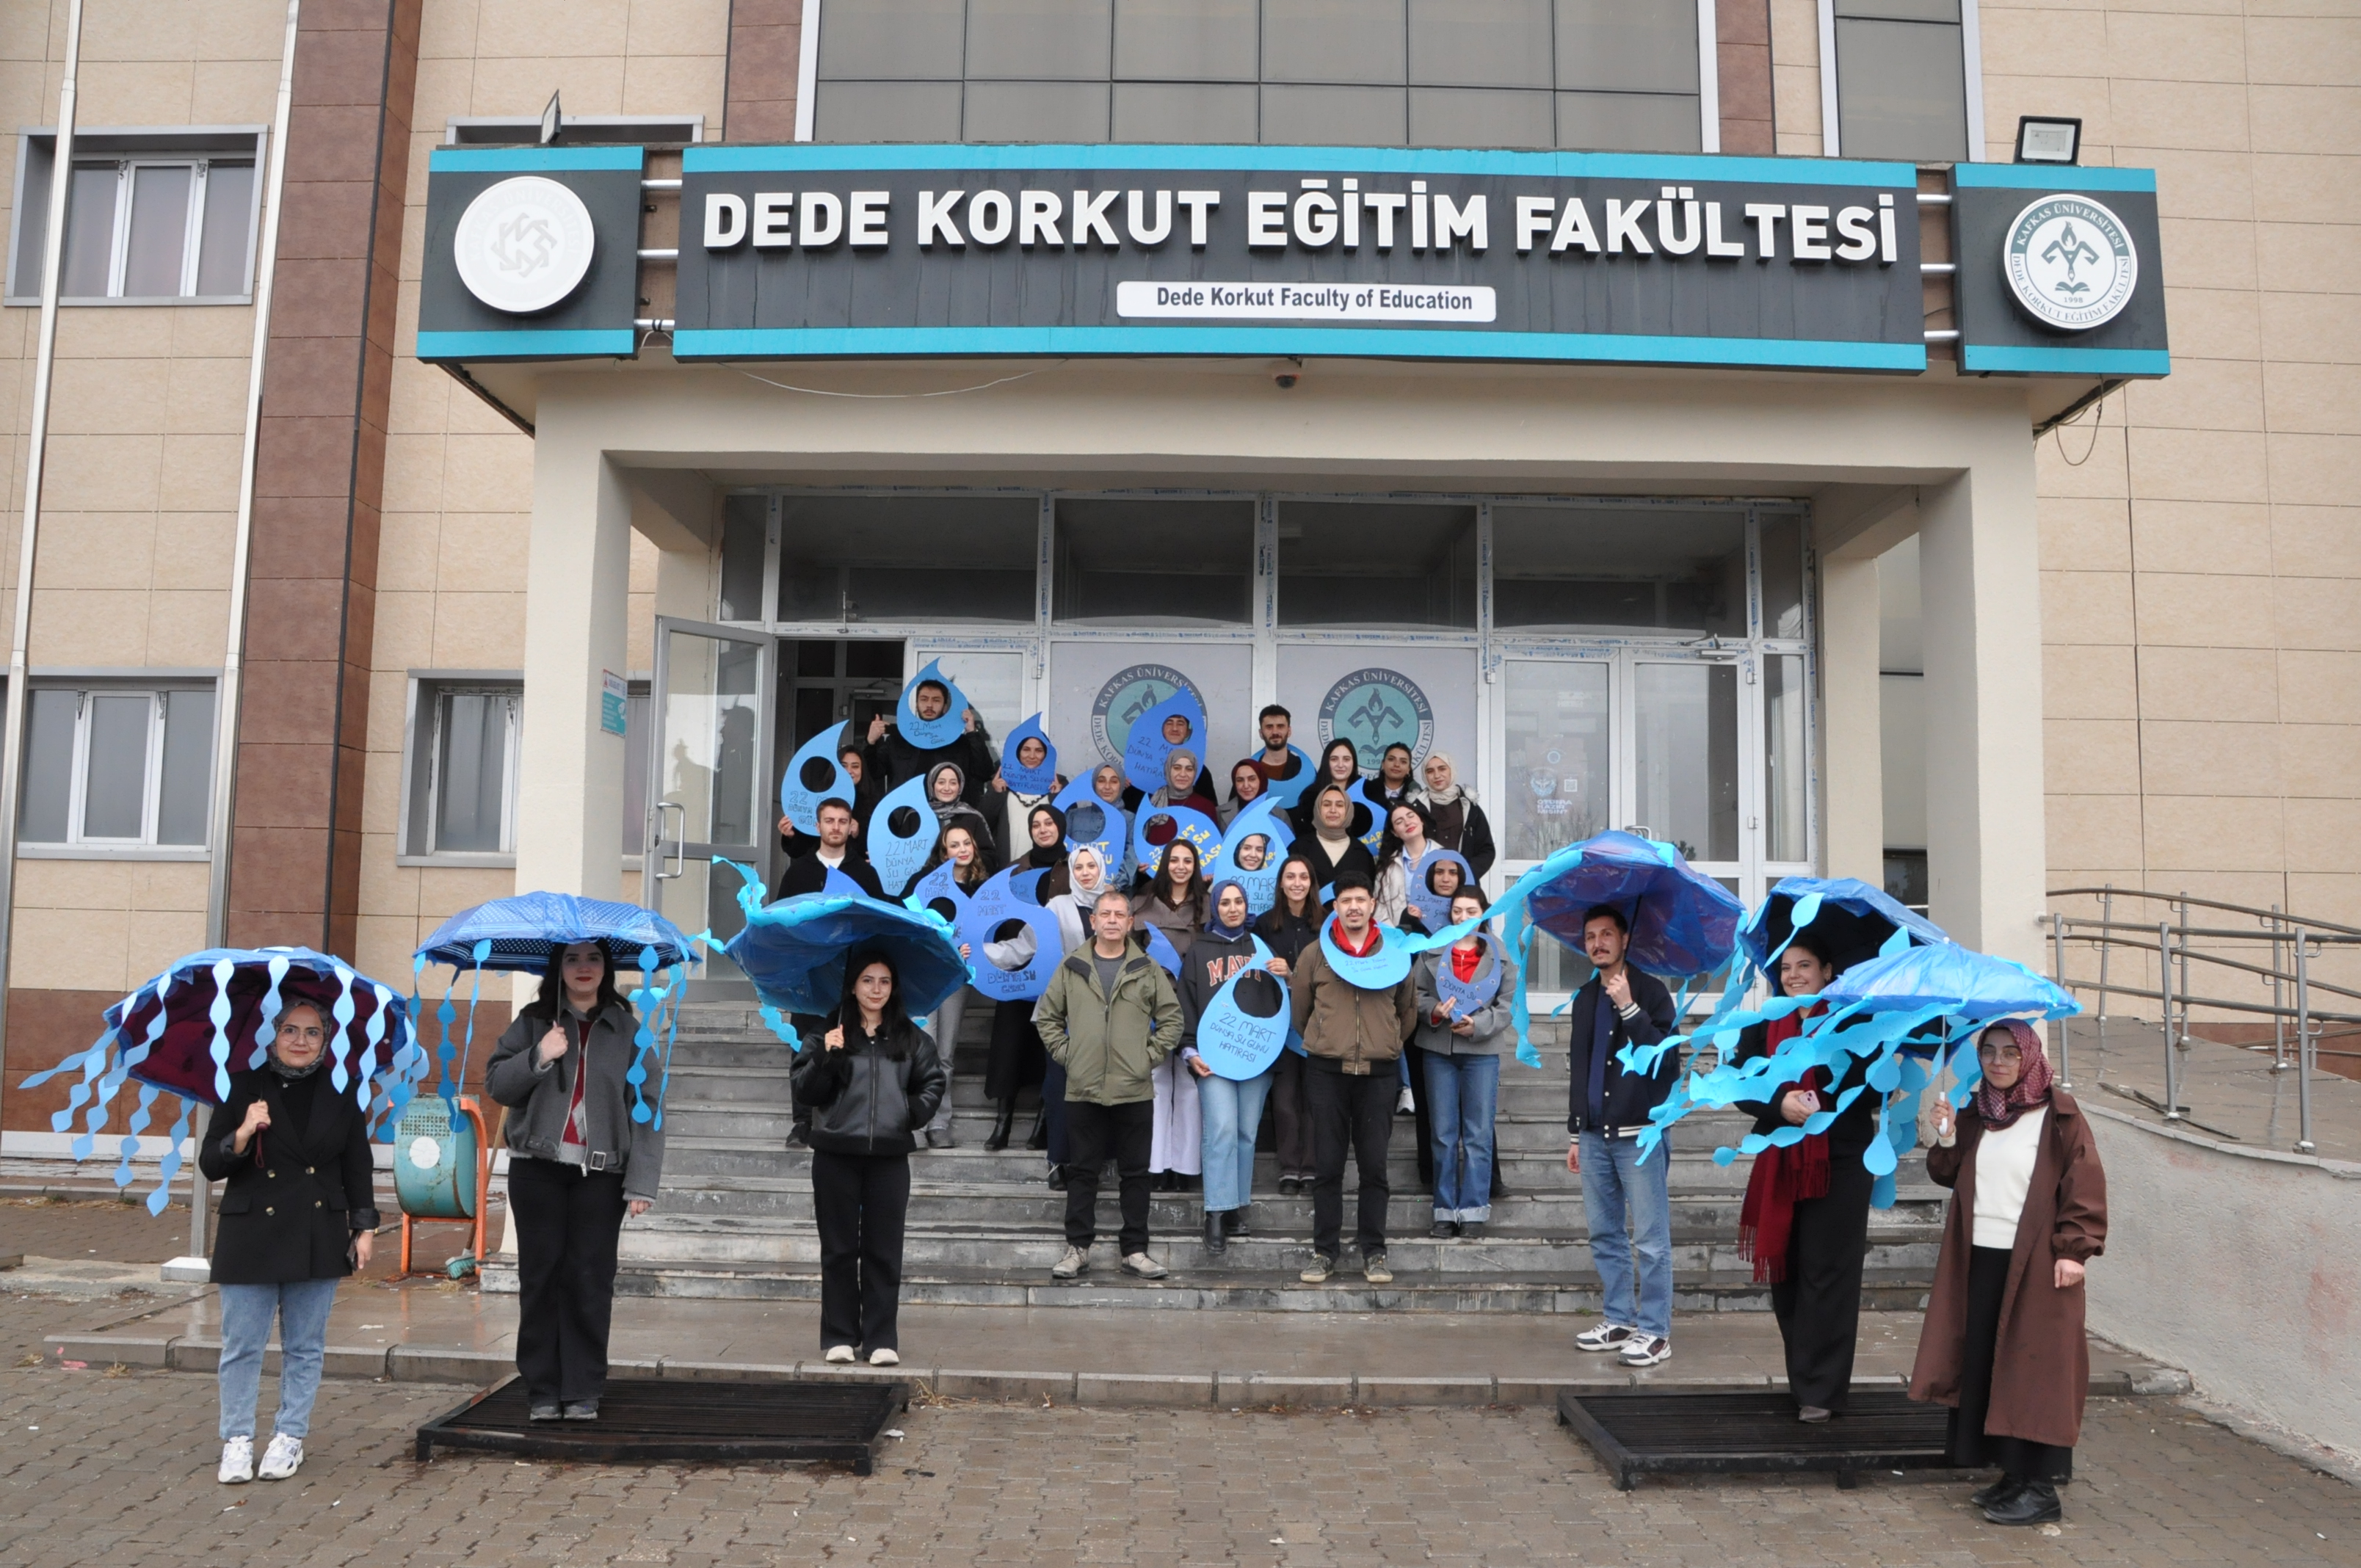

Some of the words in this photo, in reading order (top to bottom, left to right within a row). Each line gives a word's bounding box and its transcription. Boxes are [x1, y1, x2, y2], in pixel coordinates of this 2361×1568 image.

[703, 191, 890, 250] DEDE
[918, 190, 1220, 250] KORKUT
[1247, 178, 1489, 253] EĞİTİM
[1516, 186, 1898, 265] FAKÜLTESİ
[2017, 207, 2051, 246] KAFKAS
[2054, 203, 2125, 249] ÜNİVERSİTESİ
[469, 203, 499, 261] KAFKAS
[2013, 255, 2026, 285] DEDE
[2023, 285, 2061, 319] KORKUT
[2064, 307, 2103, 322] EĞİTİM
[2104, 258, 2128, 311] FAKÜLTESİ
[1157, 287, 1204, 306] Dede
[1211, 288, 1274, 306] Korkut
[1281, 288, 1349, 312] Faculty
[1356, 289, 1374, 308] of
[1379, 290, 1473, 310] Education
[1099, 672, 1134, 708] KAFKAS
[1325, 675, 1360, 711] KAFKAS
[1363, 670, 1429, 713] ÜNİVERSİTESİ
[909, 721, 922, 730] 22
[1094, 717, 1106, 742] DEDE
[1127, 744, 1153, 761] DÜNYA
[1137, 736, 1151, 747] 22
[1158, 744, 1173, 755] MA
[1411, 722, 1432, 765] KÜLTESİ
[1134, 761, 1165, 780] HATIRA
[789, 791, 808, 805] 22
[885, 841, 900, 857] 22
[903, 839, 928, 854] MART
[885, 857, 915, 868] DÜNYA
[886, 868, 899, 878] SU
[928, 871, 949, 887] 22
[925, 887, 949, 898] MART
[1009, 881, 1030, 898] 22
[1247, 876, 1276, 891] MAR
[980, 889, 1001, 901] 22
[1252, 892, 1263, 901] SU
[1415, 894, 1427, 902] 22
[977, 904, 1007, 916] MART
[987, 970, 1022, 984] DÜNYA
[1023, 969, 1036, 981] SU
[1210, 1022, 1235, 1040] DÜNYA
[1234, 1034, 1247, 1045] SU
[1219, 1012, 1237, 1029] 22
[1238, 1020, 1277, 1042] MART
[1219, 1040, 1257, 1063] HATIRASI
